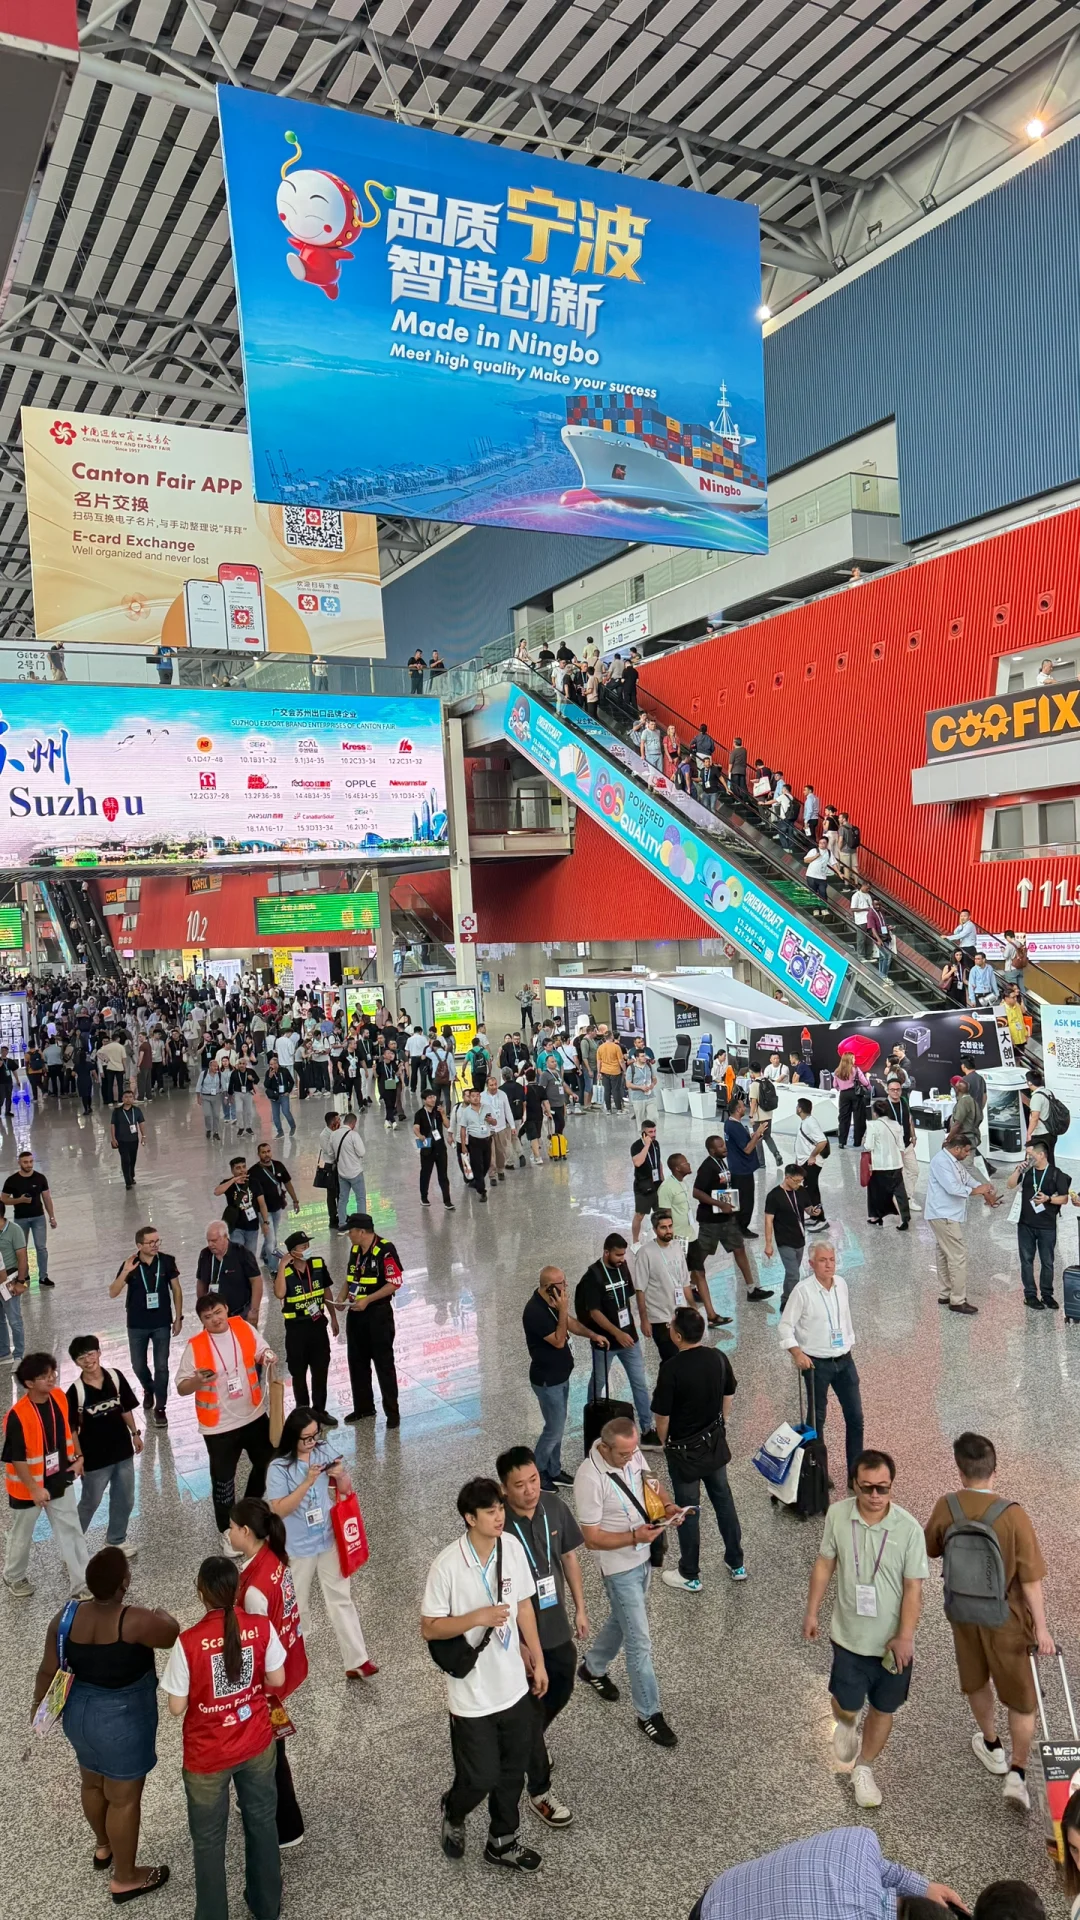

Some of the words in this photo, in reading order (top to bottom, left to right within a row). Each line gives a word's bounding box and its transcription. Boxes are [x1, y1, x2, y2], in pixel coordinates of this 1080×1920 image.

[386, 185, 651, 284] 品质宁波
[387, 244, 606, 339] 智造创新
[391, 309, 469, 343] Made
[476, 325, 500, 348] in
[508, 329, 601, 366] Ningbo
[390, 342, 431, 362] Meet
[435, 351, 469, 371] high
[473, 359, 526, 381] quality
[530, 366, 570, 385] Make
[574, 376, 607, 392] your
[610, 381, 658, 399] success
[102, 438, 122, 446] IMPORT
[138, 442, 157, 450] EXPORT
[72, 462, 150, 486] Canton
[156, 471, 196, 490] Fair
[201, 476, 242, 495] APP
[700, 476, 741, 496] Ningbo
[74, 491, 150, 513] 名片交换
[72, 530, 121, 546] E-card
[126, 535, 196, 553] Exchange
[72, 545, 93, 556] Well
[96, 547, 142, 561] organized
[144, 551, 162, 561] and
[165, 555, 190, 564] never
[192, 555, 210, 565] lost
[18, 660, 46, 670] 2号门
[272, 708, 358, 718] 广交会苏州出口品牌企业
[931, 690, 1080, 752] COOFIX
[342, 742, 366, 750] Kress
[345, 780, 376, 788] OPPLE
[629, 791, 664, 828] POWERED
[639, 814, 648, 828] BY
[621, 814, 662, 858] QUALITY
[744, 890, 784, 930] ORIENTCRAFT
[186, 910, 208, 942] 10.2
[1054, 1019, 1069, 1027] ASK
[1070, 1020, 1080, 1028] ME
[960, 1040, 984, 1050] 大创设计
[294, 1285, 302, 1294] 安
[312, 1280, 320, 1290] 保
[201, 1636, 224, 1650] Sca
[240, 1626, 259, 1642] Me!
[198, 1702, 232, 1714] Canton
[234, 1692, 252, 1708] Fair
